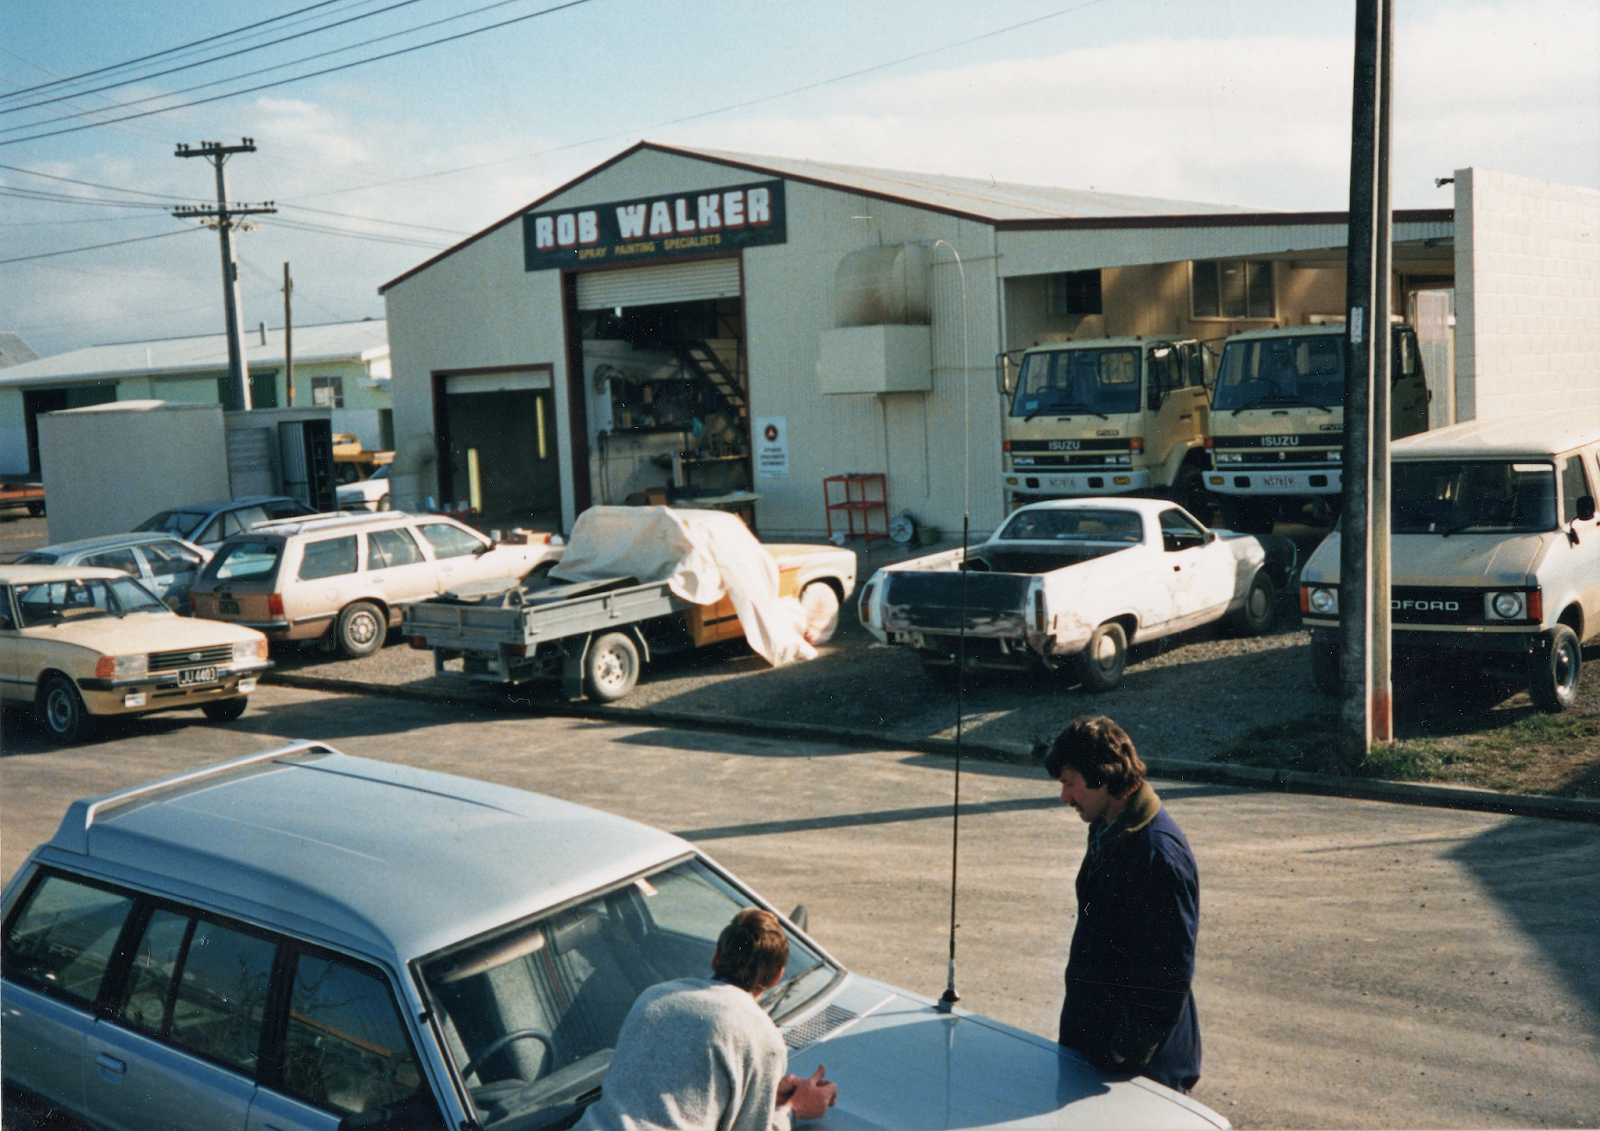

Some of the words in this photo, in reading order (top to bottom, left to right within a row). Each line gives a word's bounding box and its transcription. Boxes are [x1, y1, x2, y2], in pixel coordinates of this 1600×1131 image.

[535, 210, 598, 250] ROB
[615, 188, 771, 241] WALKER
[578, 247, 607, 260] SPRAY
[614, 242, 655, 256] PAINTING
[664, 234, 721, 250] SPECIALISTS
[1048, 441, 1081, 450] ISUZU
[1261, 436, 1299, 446] ISUZU
[1391, 600, 1459, 611] DFORD
